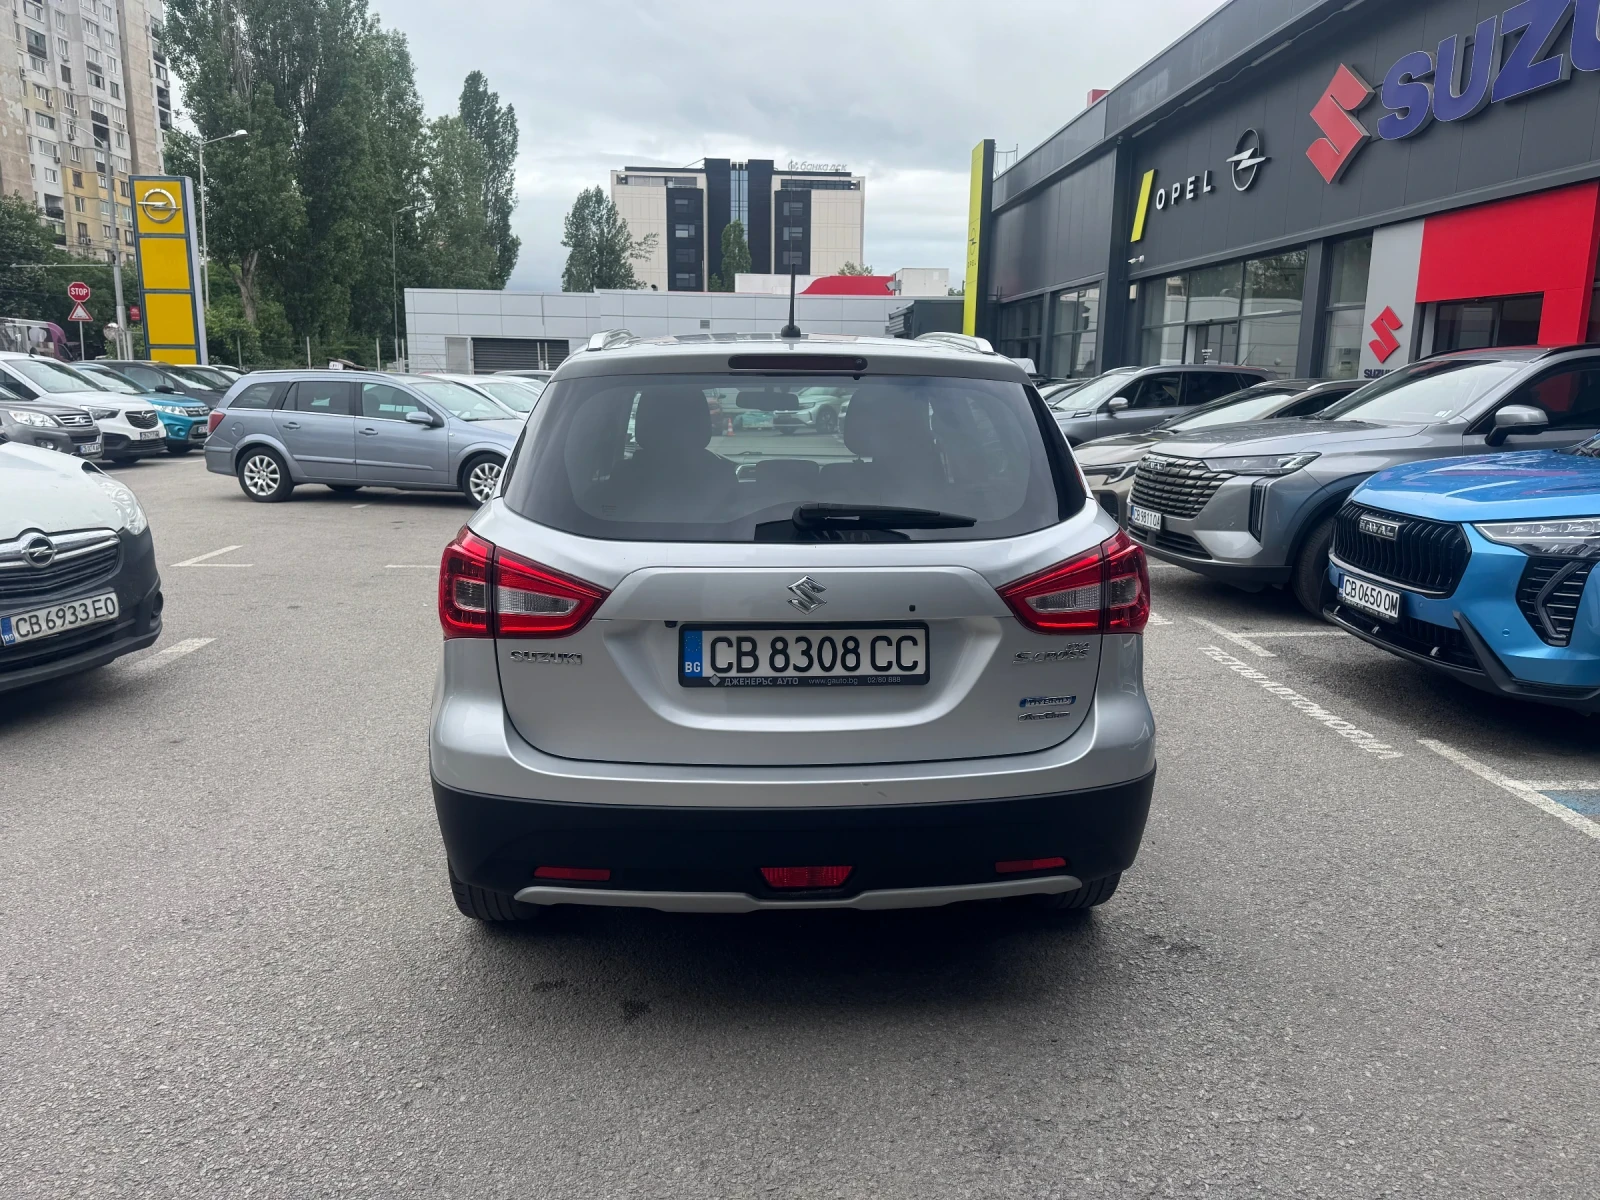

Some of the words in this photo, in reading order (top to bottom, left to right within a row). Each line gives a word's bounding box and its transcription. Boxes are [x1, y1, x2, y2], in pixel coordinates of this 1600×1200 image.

[1156, 169, 1212, 210] OPEL
[70, 287, 88, 296] STOP
[1360, 519, 1394, 537] HAVAL
[1344, 579, 1357, 599] CB
[1358, 583, 1382, 609] 0650
[1383, 592, 1399, 615] OM
[15, 614, 42, 639] CB
[45, 602, 90, 631] 6933
[91, 596, 116, 619] EO
[510, 649, 583, 665] SUZUKI
[710, 636, 759, 673] CB
[768, 636, 861, 673] 8308
[870, 635, 919, 672] CC
[1197, 645, 1269, 679] ТЕСТОВ
[685, 662, 701, 673] BG
[724, 677, 773, 686] ДЖЕНЕРЪС
[776, 677, 799, 685] АУТО
[808, 676, 858, 685] www.gauto.bg
